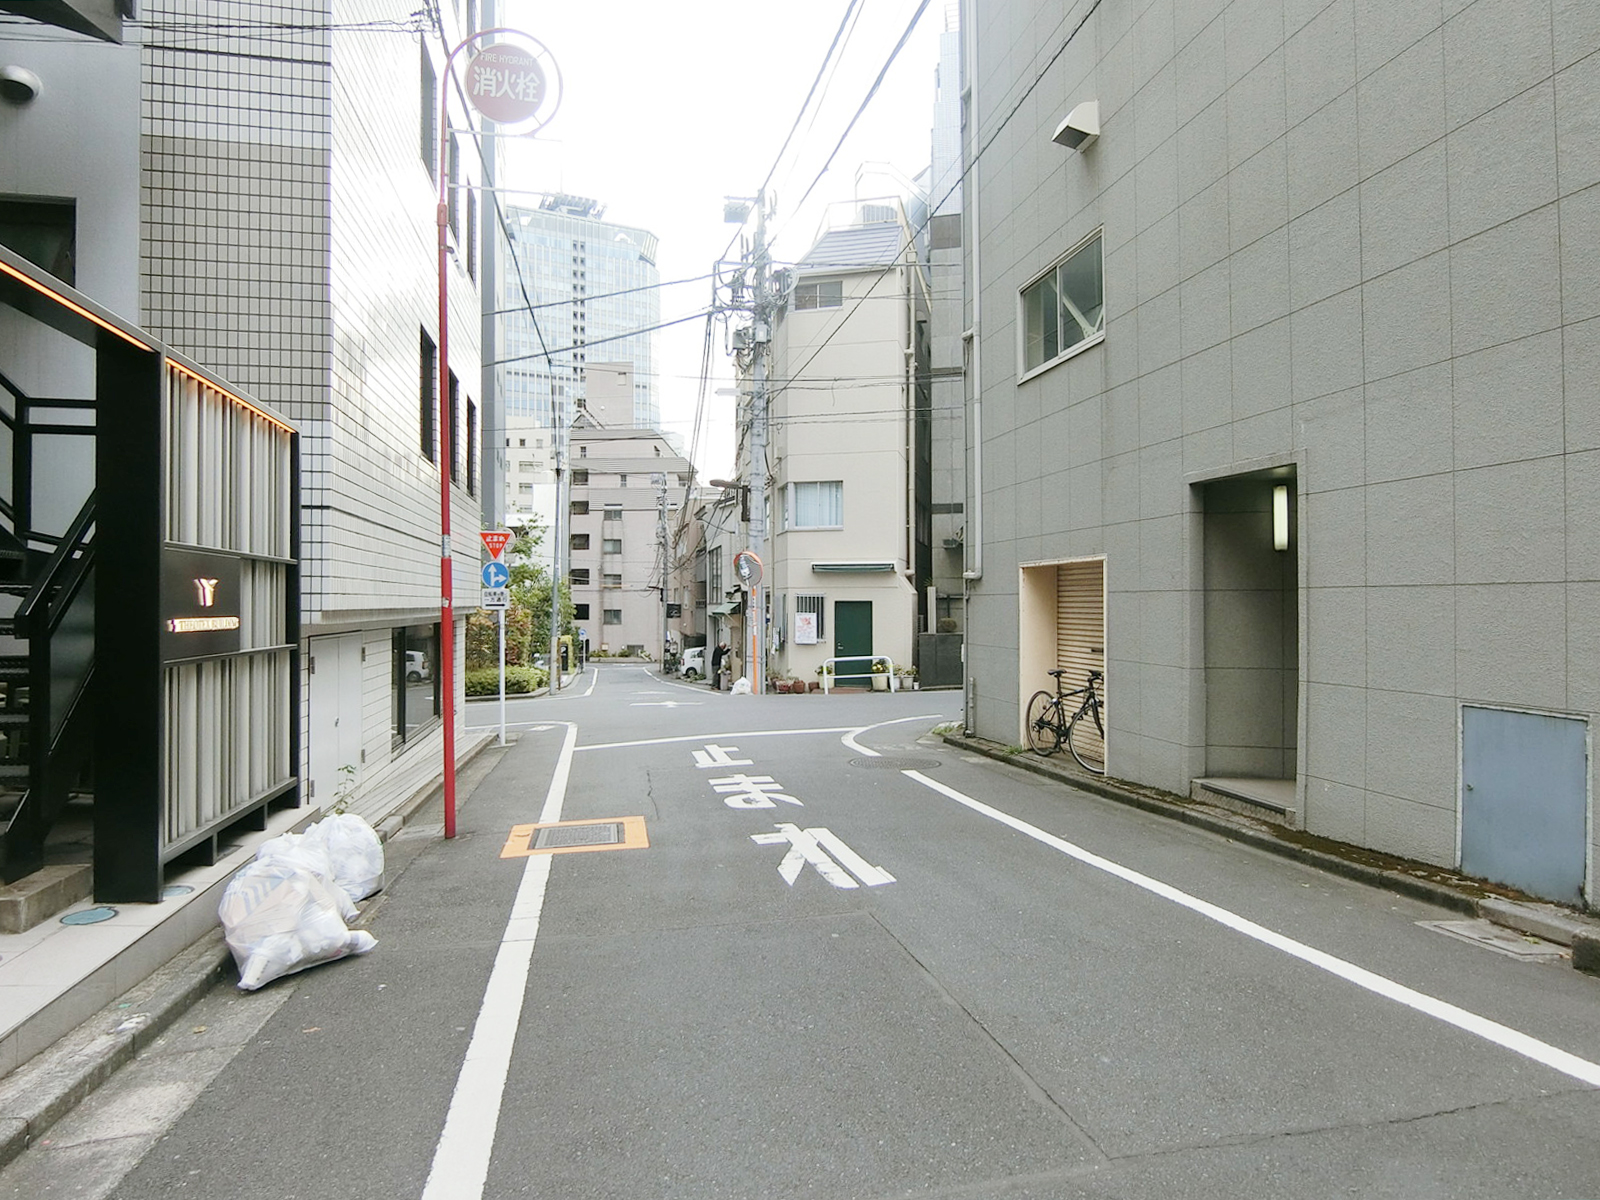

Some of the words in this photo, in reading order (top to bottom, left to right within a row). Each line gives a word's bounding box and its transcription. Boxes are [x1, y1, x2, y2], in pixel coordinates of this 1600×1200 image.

[480, 53, 497, 63] FIRE
[499, 55, 534, 67] HYDRANT
[473, 66, 540, 101] 消火栓
[691, 744, 897, 889] 止まれ
